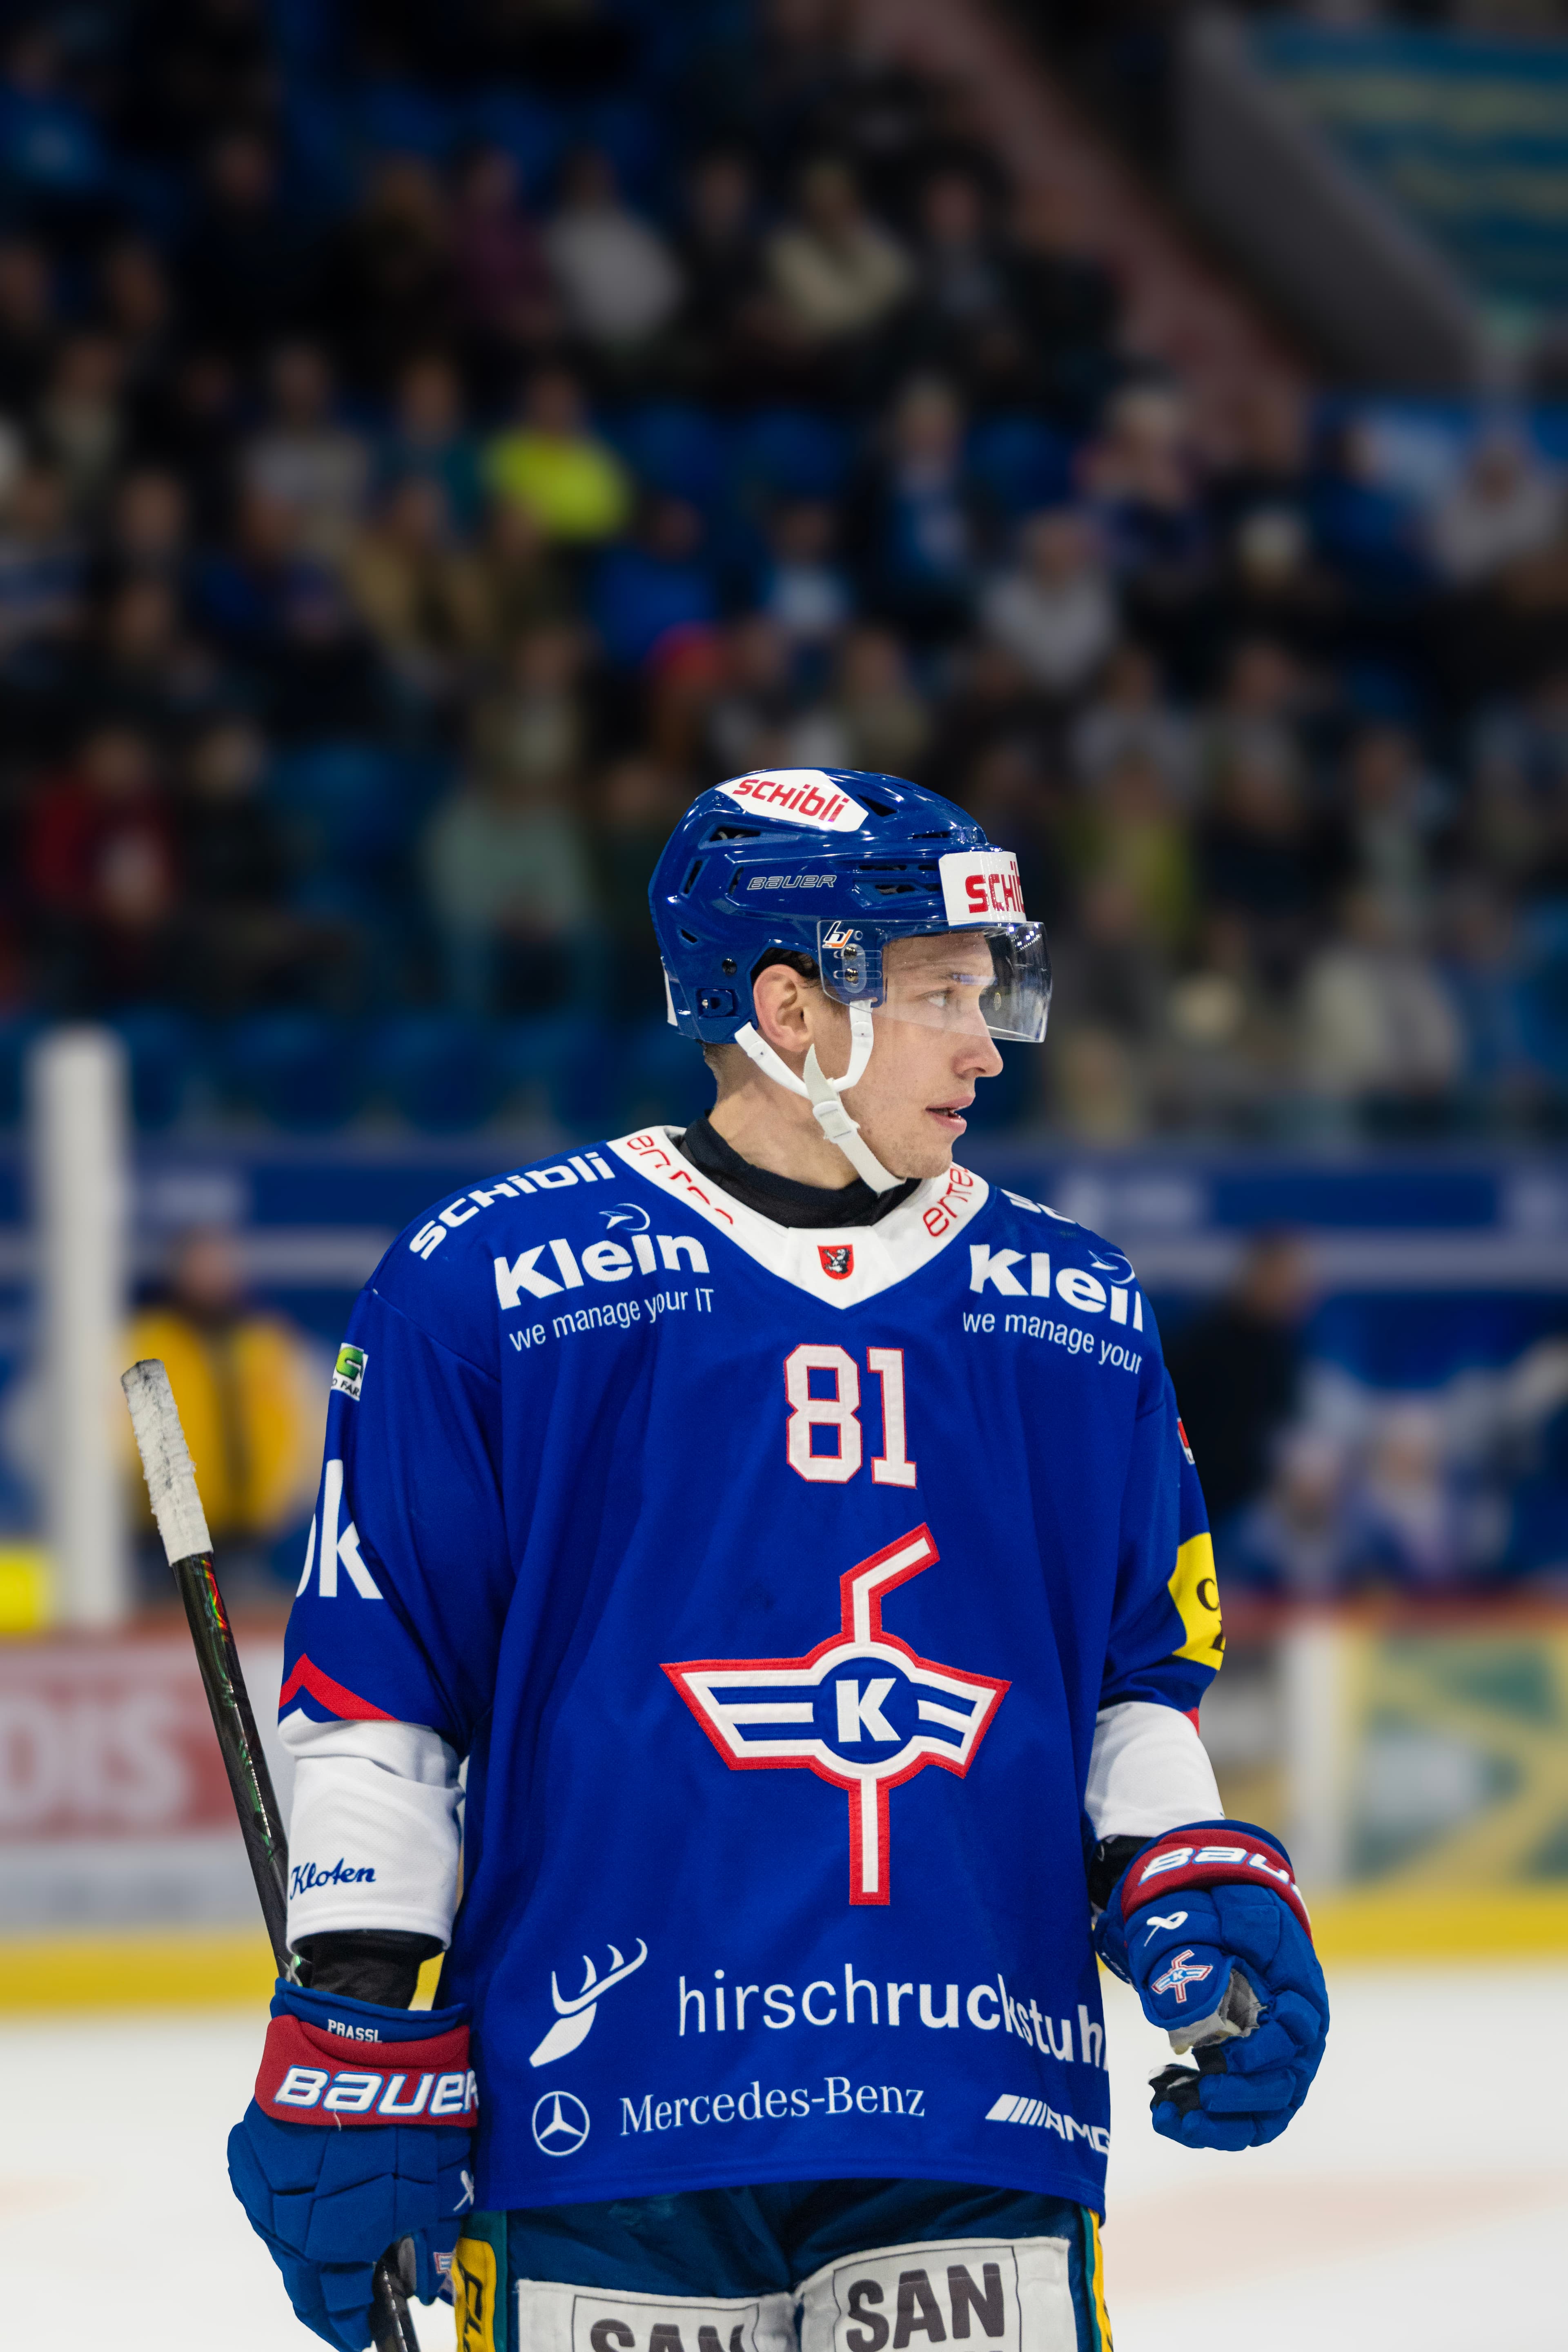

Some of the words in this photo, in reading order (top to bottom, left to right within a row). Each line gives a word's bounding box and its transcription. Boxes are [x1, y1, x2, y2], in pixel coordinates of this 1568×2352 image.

[495, 1234, 710, 1310] Klein
[509, 1324, 546, 1352] we
[552, 1300, 641, 1339] manage
[644, 1290, 688, 1323] your
[696, 1287, 714, 1313] IT
[963, 1312, 996, 1333] we
[1005, 1314, 1095, 1355] manage
[1098, 1339, 1143, 1374] your
[783, 1343, 918, 1490] 81
[835, 1677, 901, 1743] K
[290, 1857, 376, 1901] Kloten
[1172, 1970, 1184, 1981] K
[327, 2019, 383, 2044] PRASSL
[619, 2076, 925, 2136] Mercedes-Benz
[846, 2262, 1005, 2352] SAN
